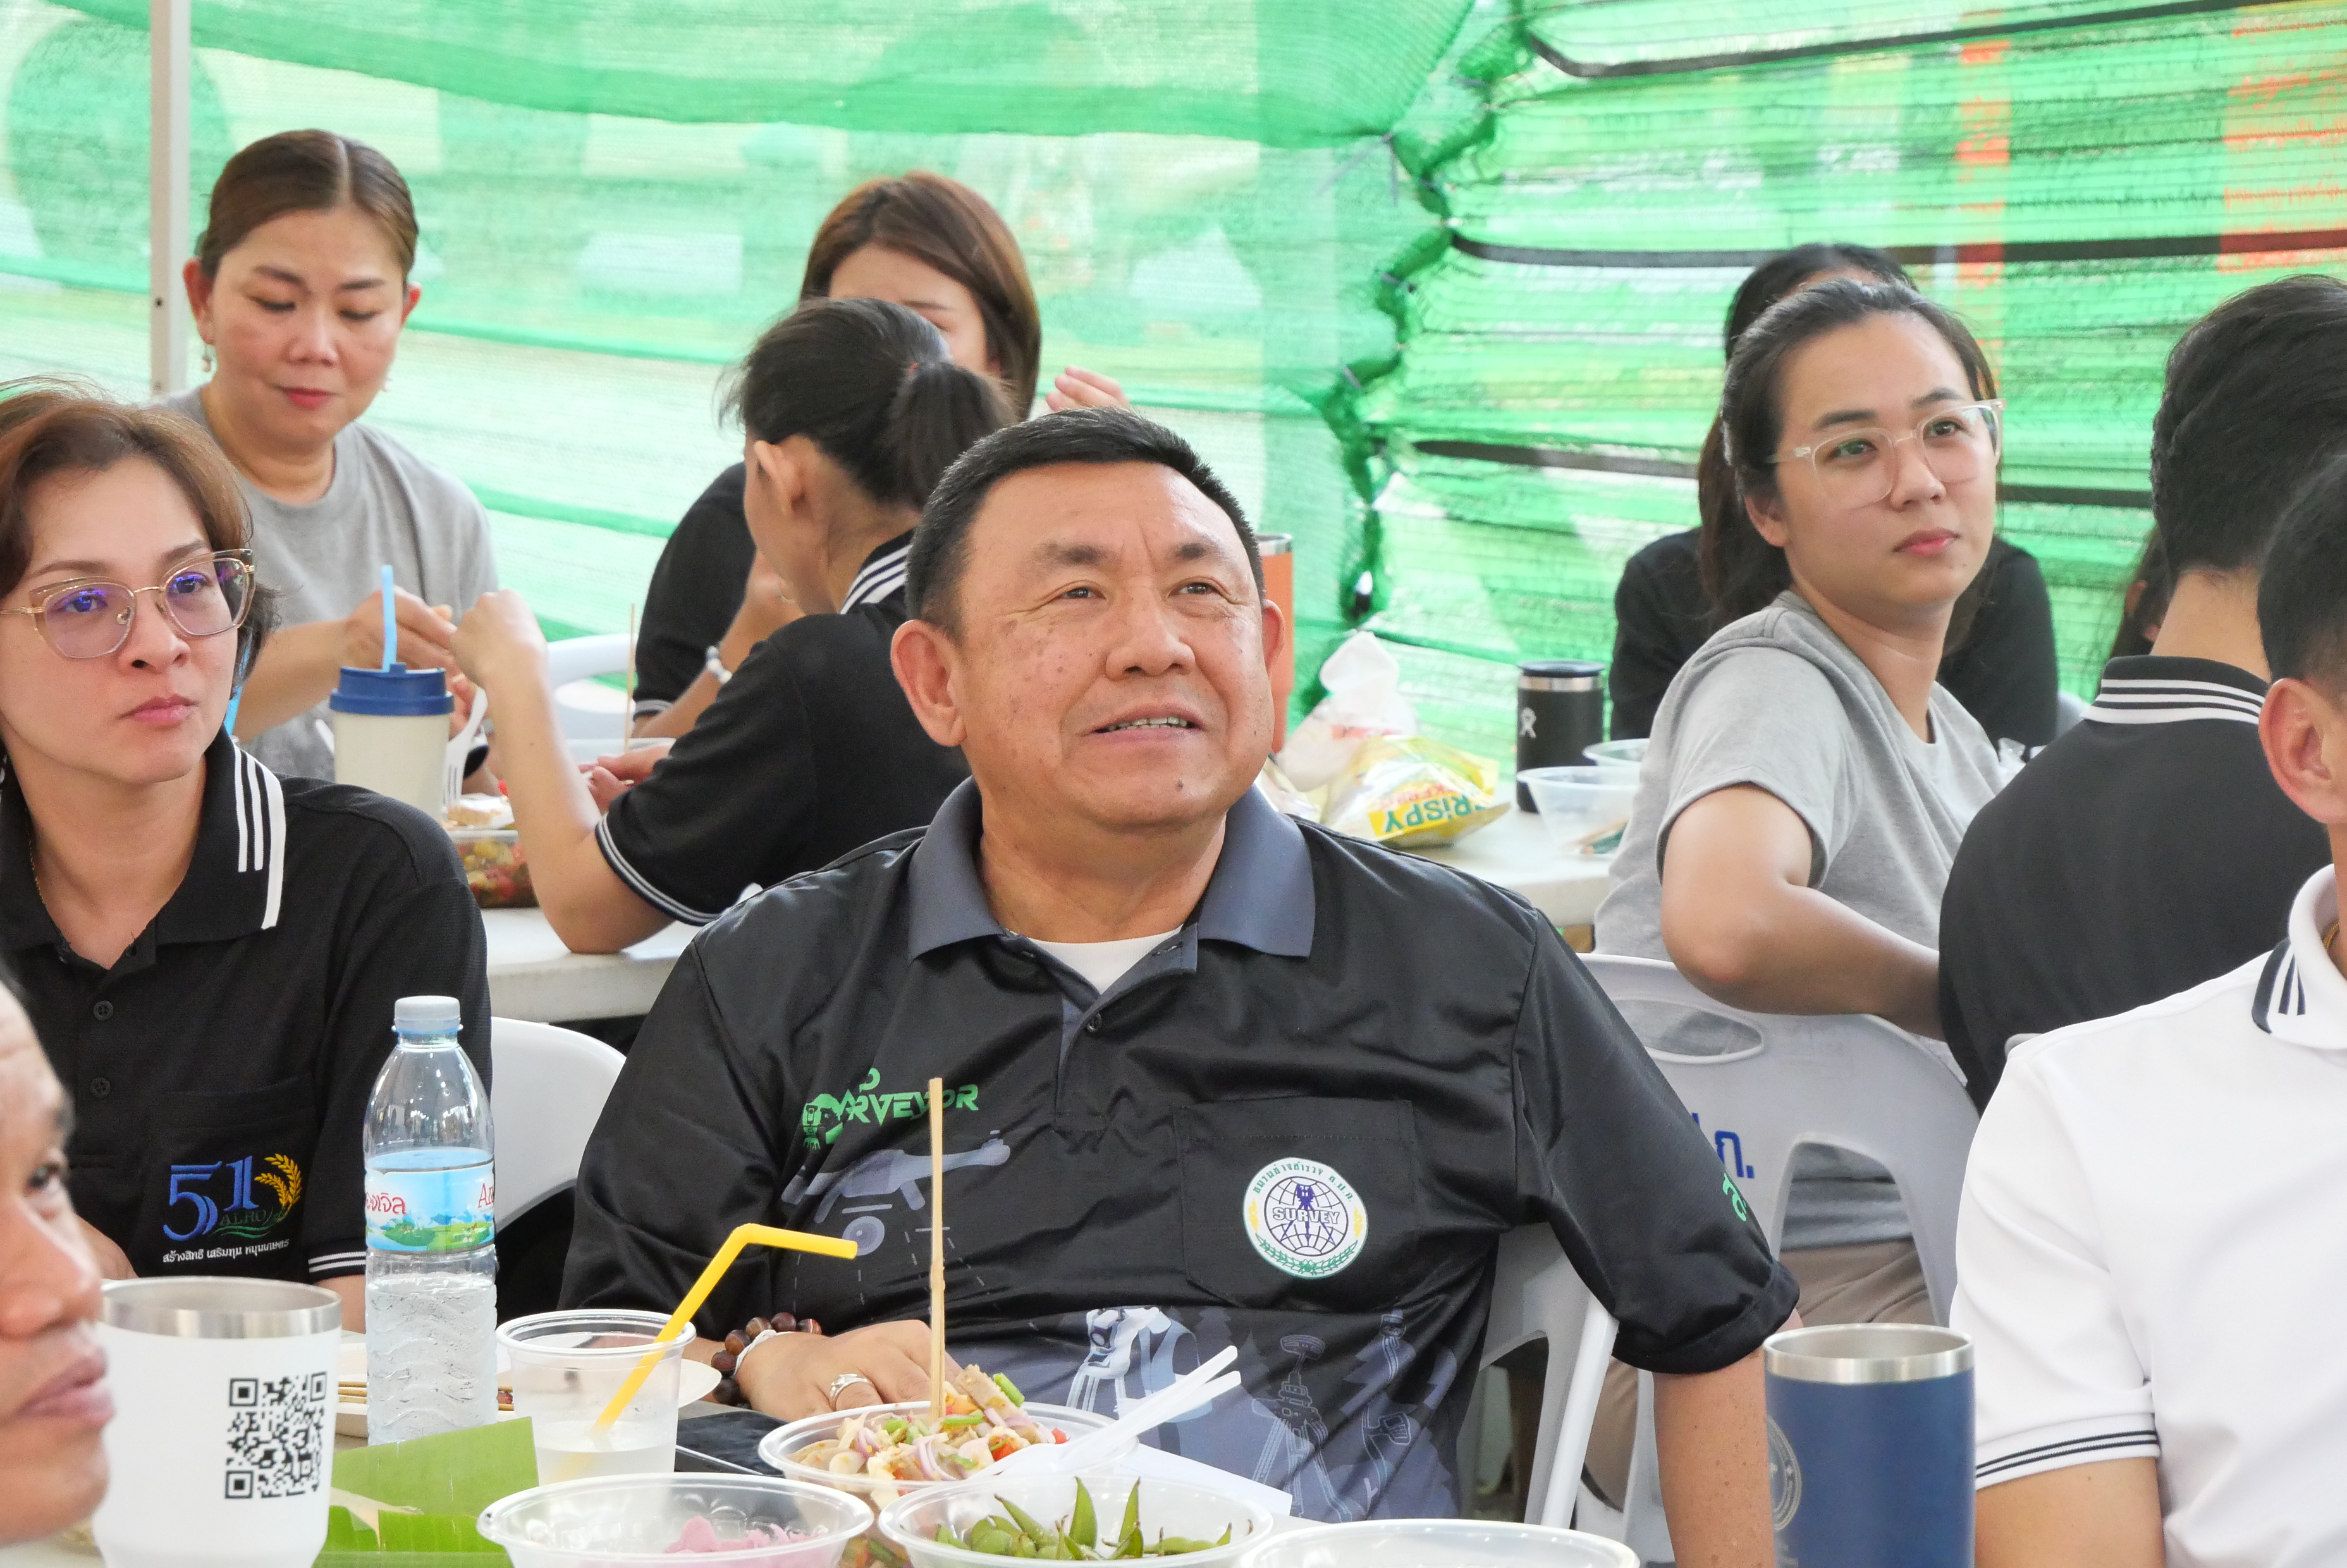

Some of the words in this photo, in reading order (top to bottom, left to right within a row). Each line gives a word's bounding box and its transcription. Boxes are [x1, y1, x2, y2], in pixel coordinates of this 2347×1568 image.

[1385, 795, 1483, 832] RiSPY
[162, 1155, 259, 1241] 51
[1272, 1207, 1340, 1224] SURVEY
